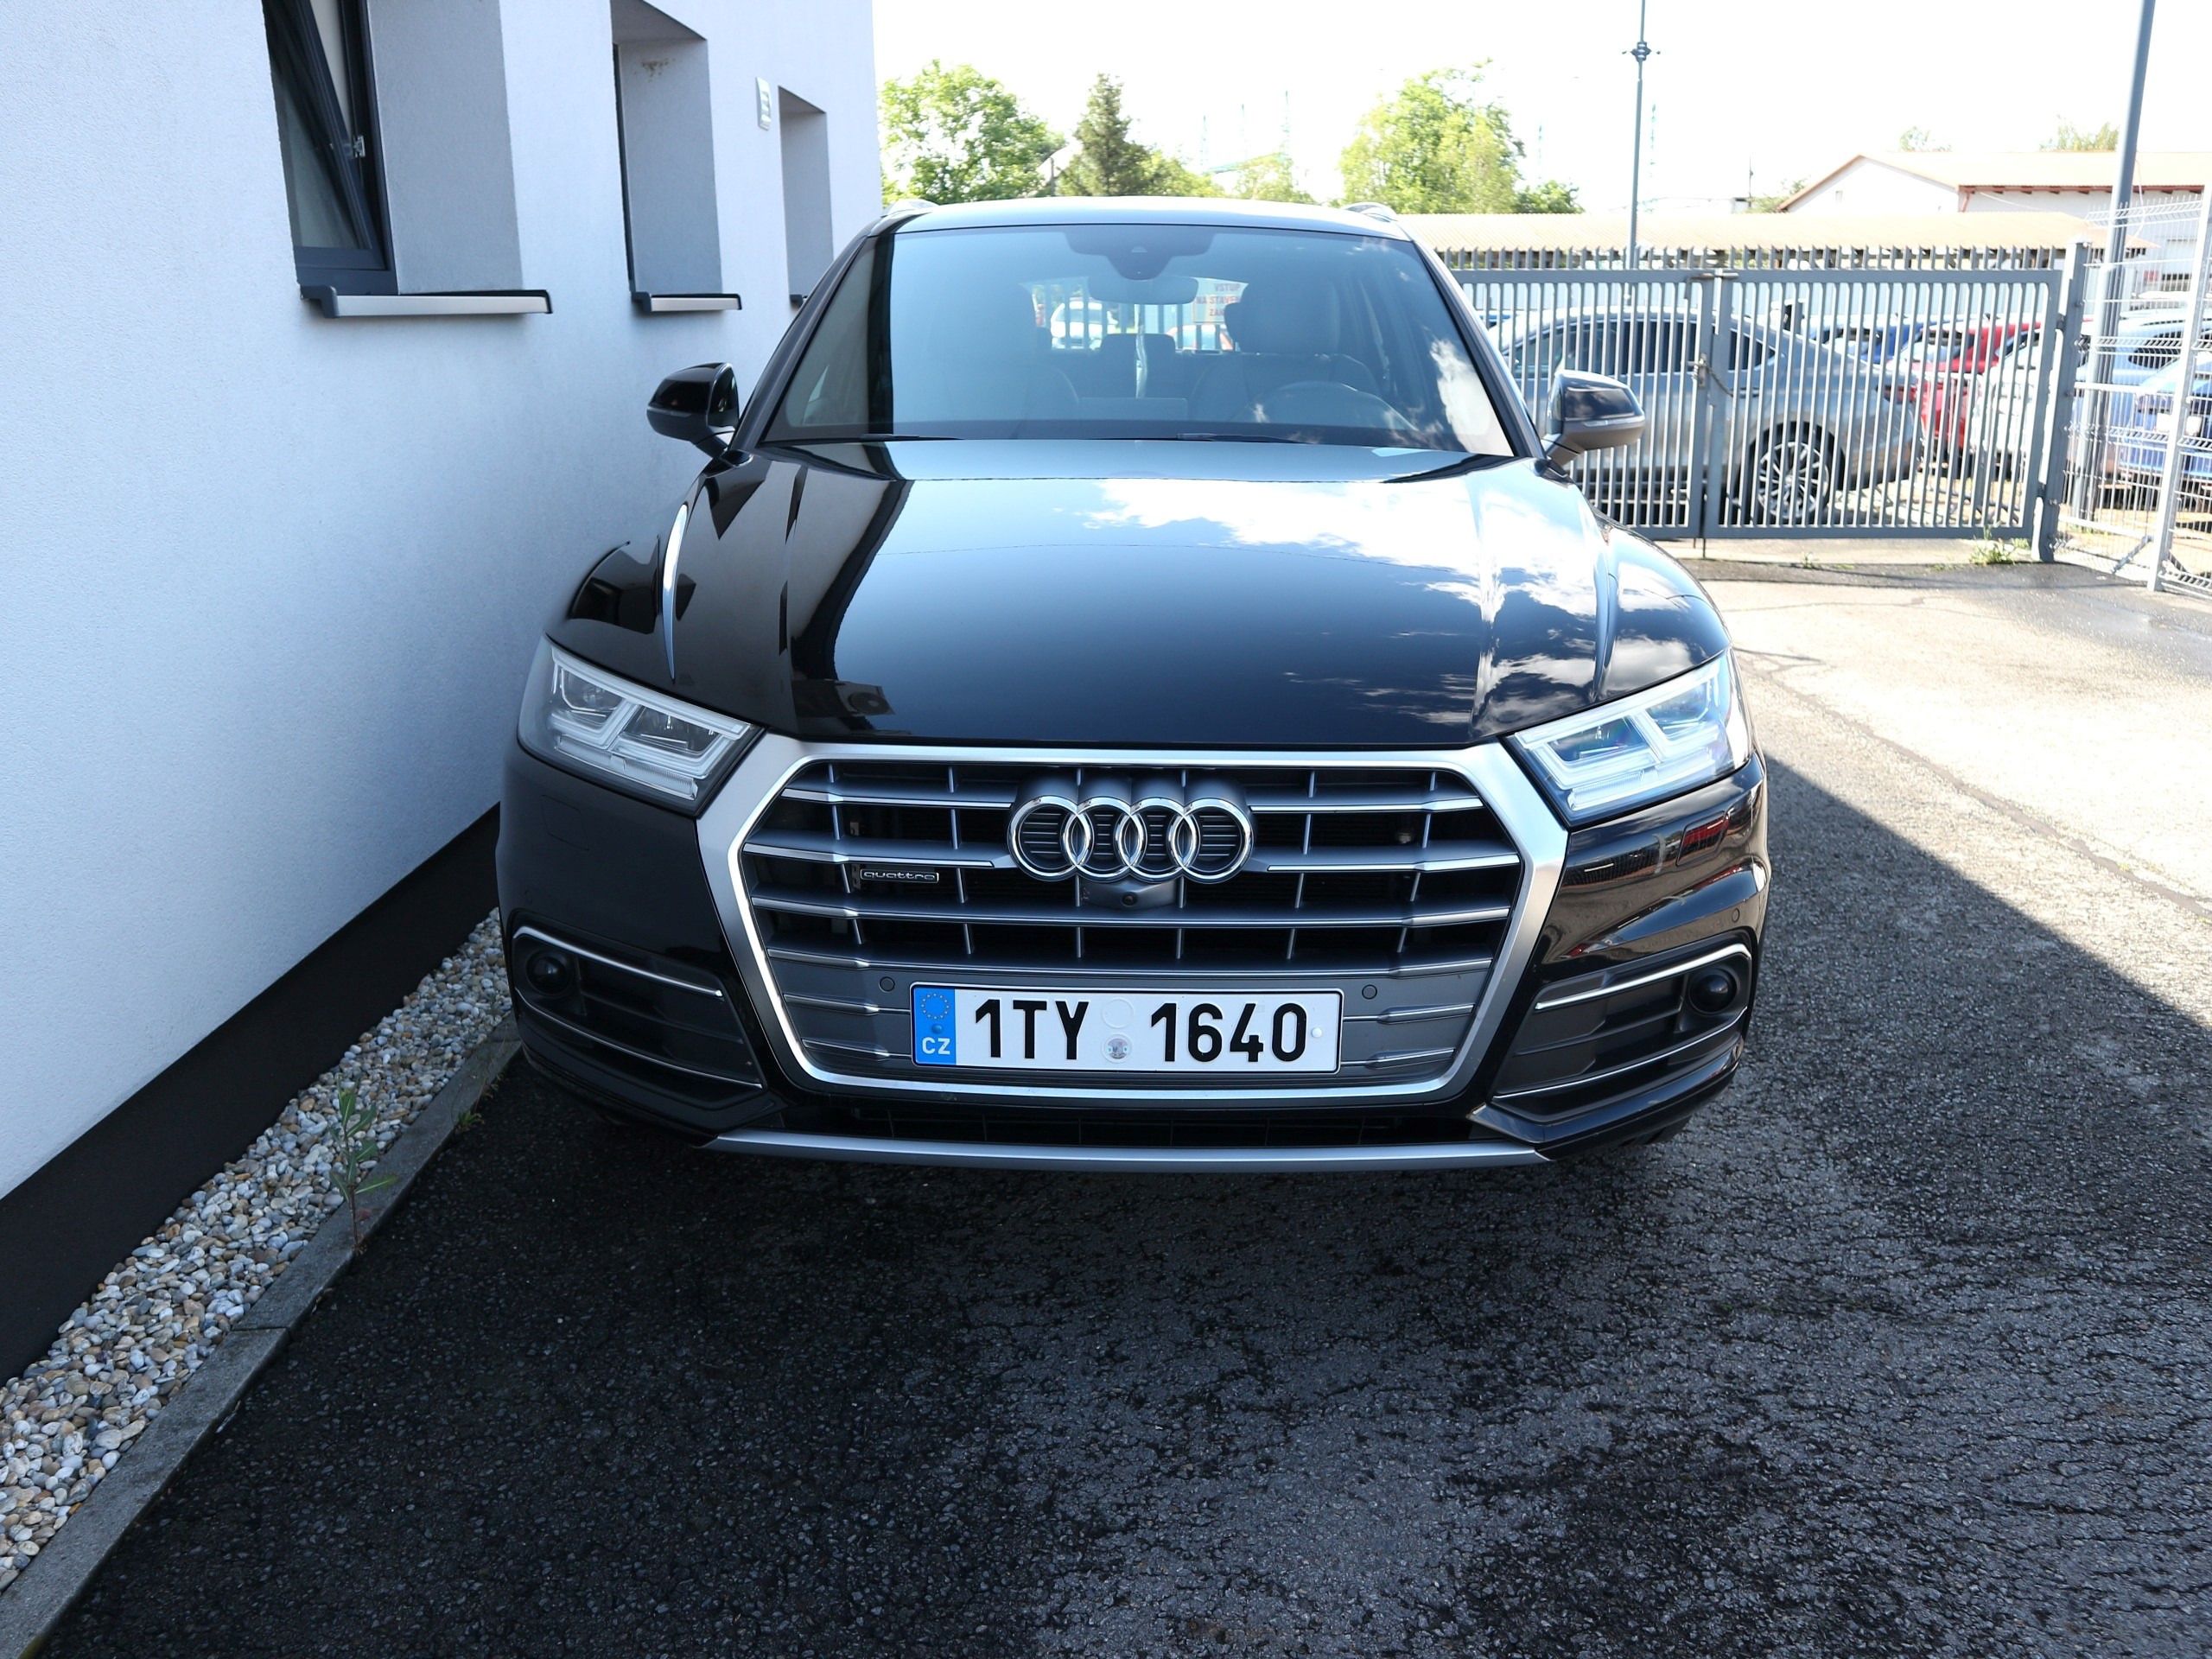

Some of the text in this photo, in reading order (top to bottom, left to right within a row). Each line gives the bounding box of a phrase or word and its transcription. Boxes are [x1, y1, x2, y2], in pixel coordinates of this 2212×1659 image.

[864, 871, 936, 880] quattro
[976, 999, 1307, 1063] 1TY 1640
[922, 1036, 950, 1055] CZ
